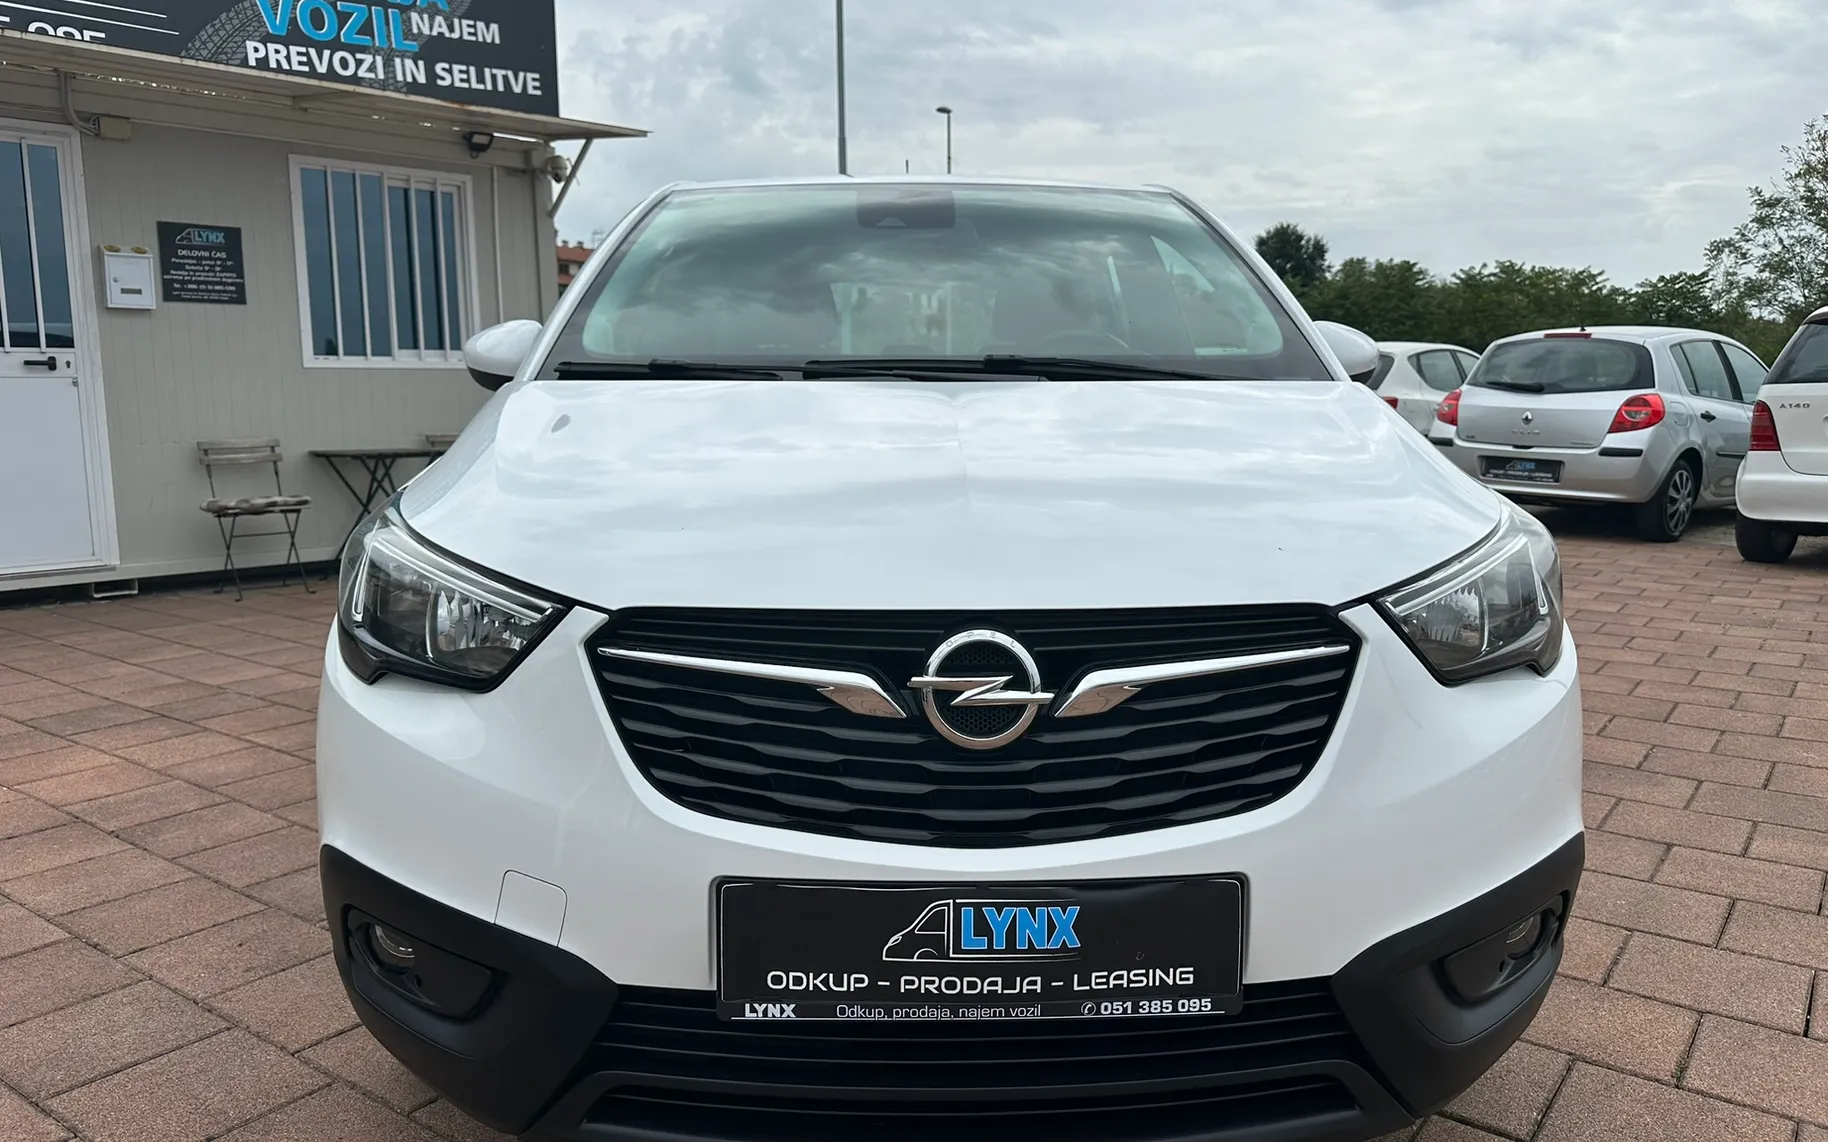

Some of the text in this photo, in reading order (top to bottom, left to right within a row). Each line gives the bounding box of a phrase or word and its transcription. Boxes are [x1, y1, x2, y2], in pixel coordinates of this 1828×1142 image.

[256, 0, 419, 52] VOZIL
[411, 11, 501, 44] NAJEM
[245, 40, 543, 96] PREVOZI IN SELITVE
[193, 229, 226, 244] LYNX
[177, 249, 209, 258] DELOVNI
[945, 631, 1016, 649] OPEL
[960, 905, 1081, 950] LYNX
[766, 970, 869, 992] ODKUP
[899, 975, 1042, 995] PRODAJA
[1073, 967, 1194, 991] LEASING
[744, 998, 1212, 1021] LYNX Odkup, prodaja, najem vozil 051 385 095
